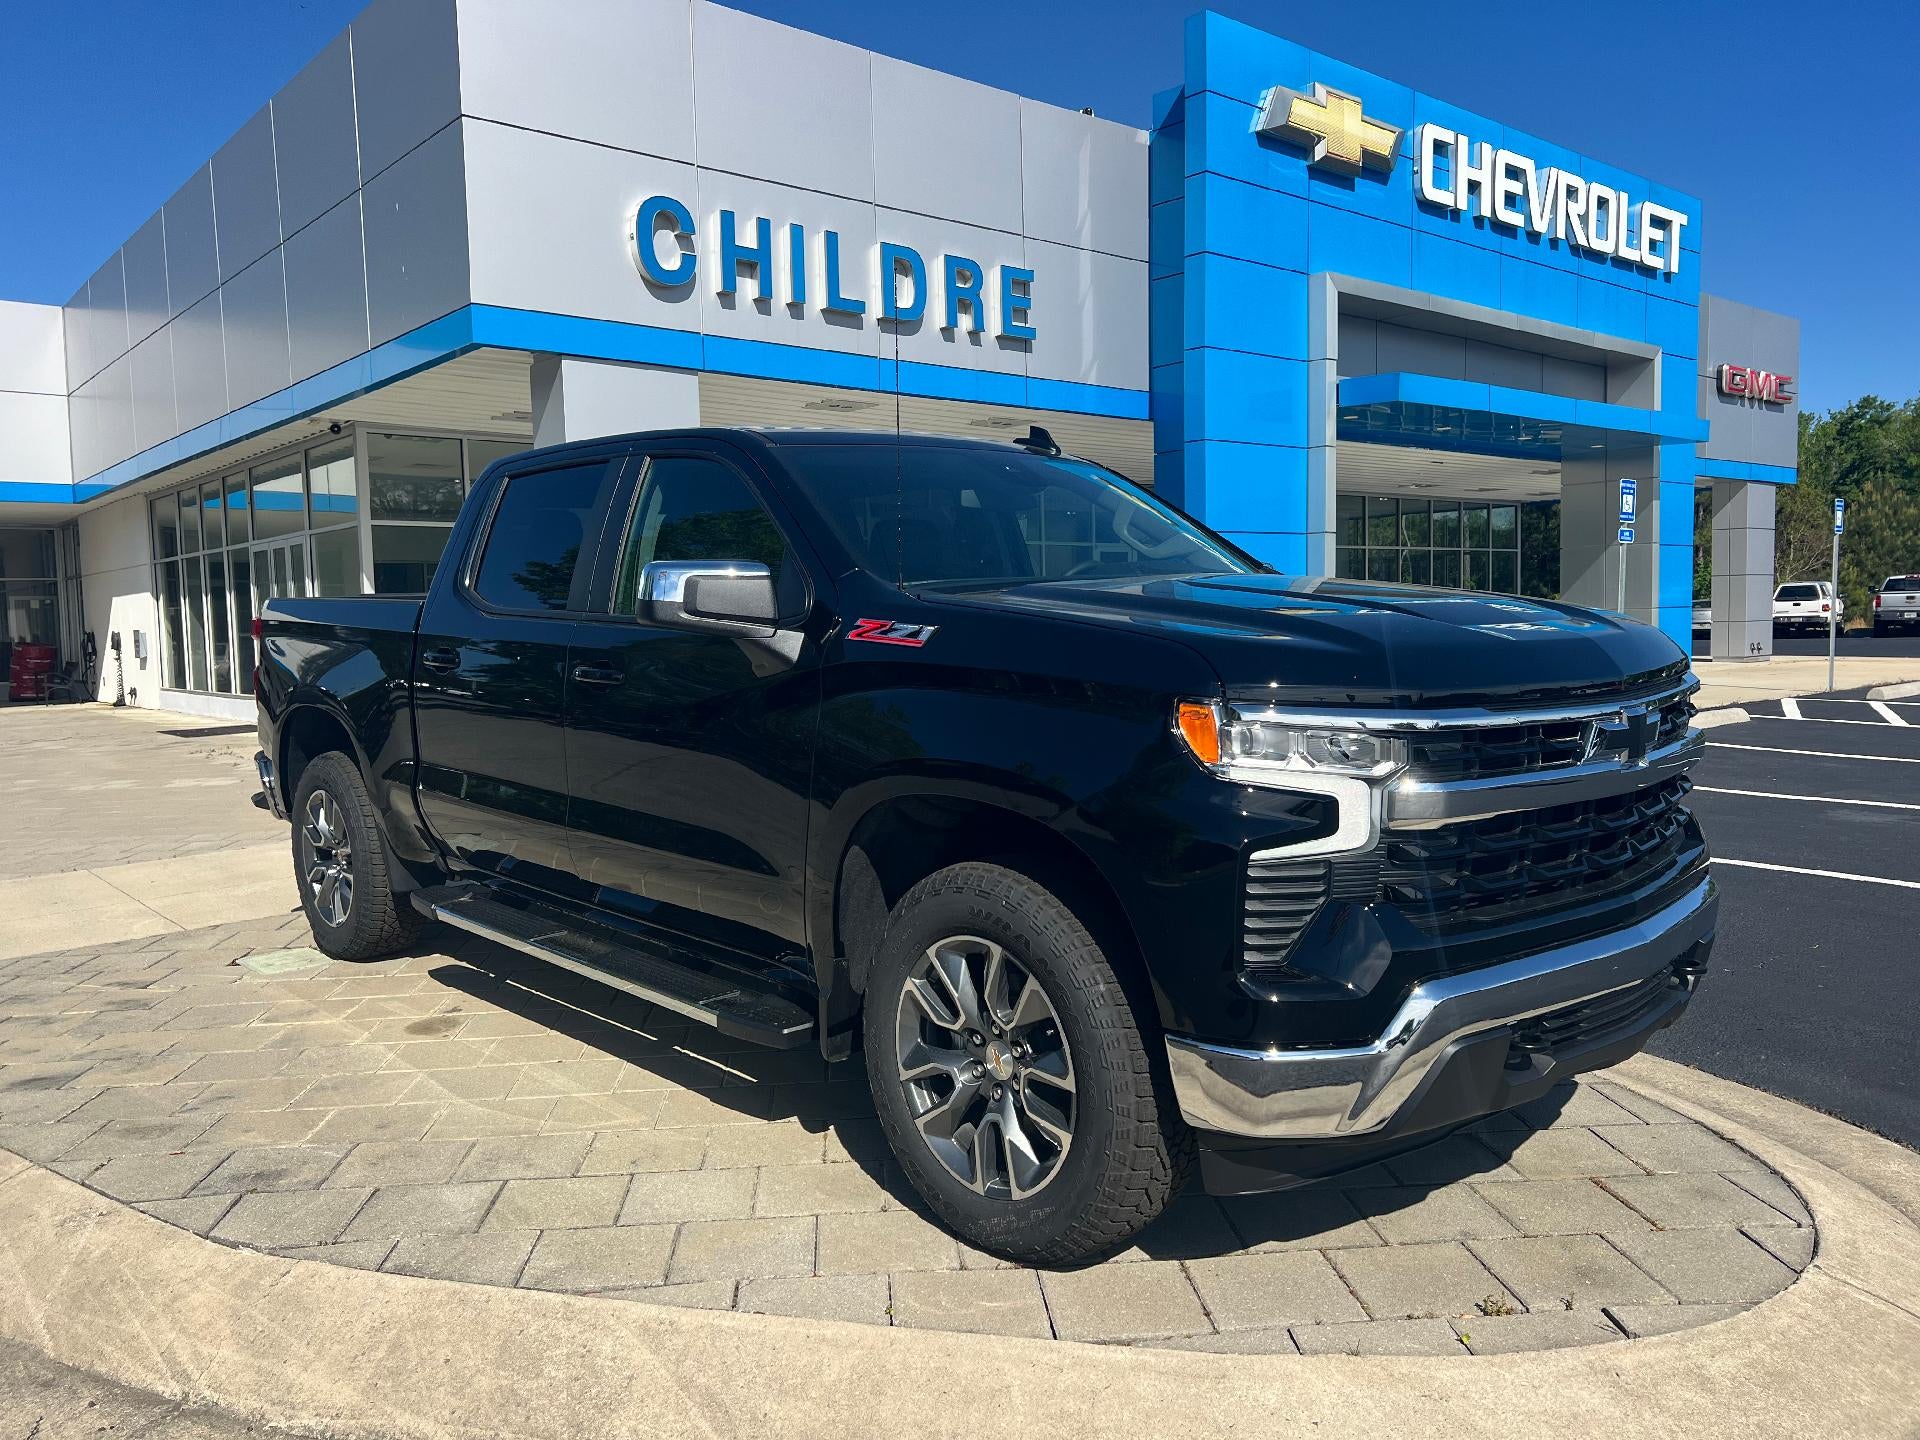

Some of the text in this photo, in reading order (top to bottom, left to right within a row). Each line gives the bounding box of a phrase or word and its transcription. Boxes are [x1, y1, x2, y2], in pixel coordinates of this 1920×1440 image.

[1419, 121, 1688, 274] CHEVROLET
[632, 195, 1037, 341] CHILDRE
[1722, 363, 1793, 405] GMC
[845, 618, 941, 647] Z71
